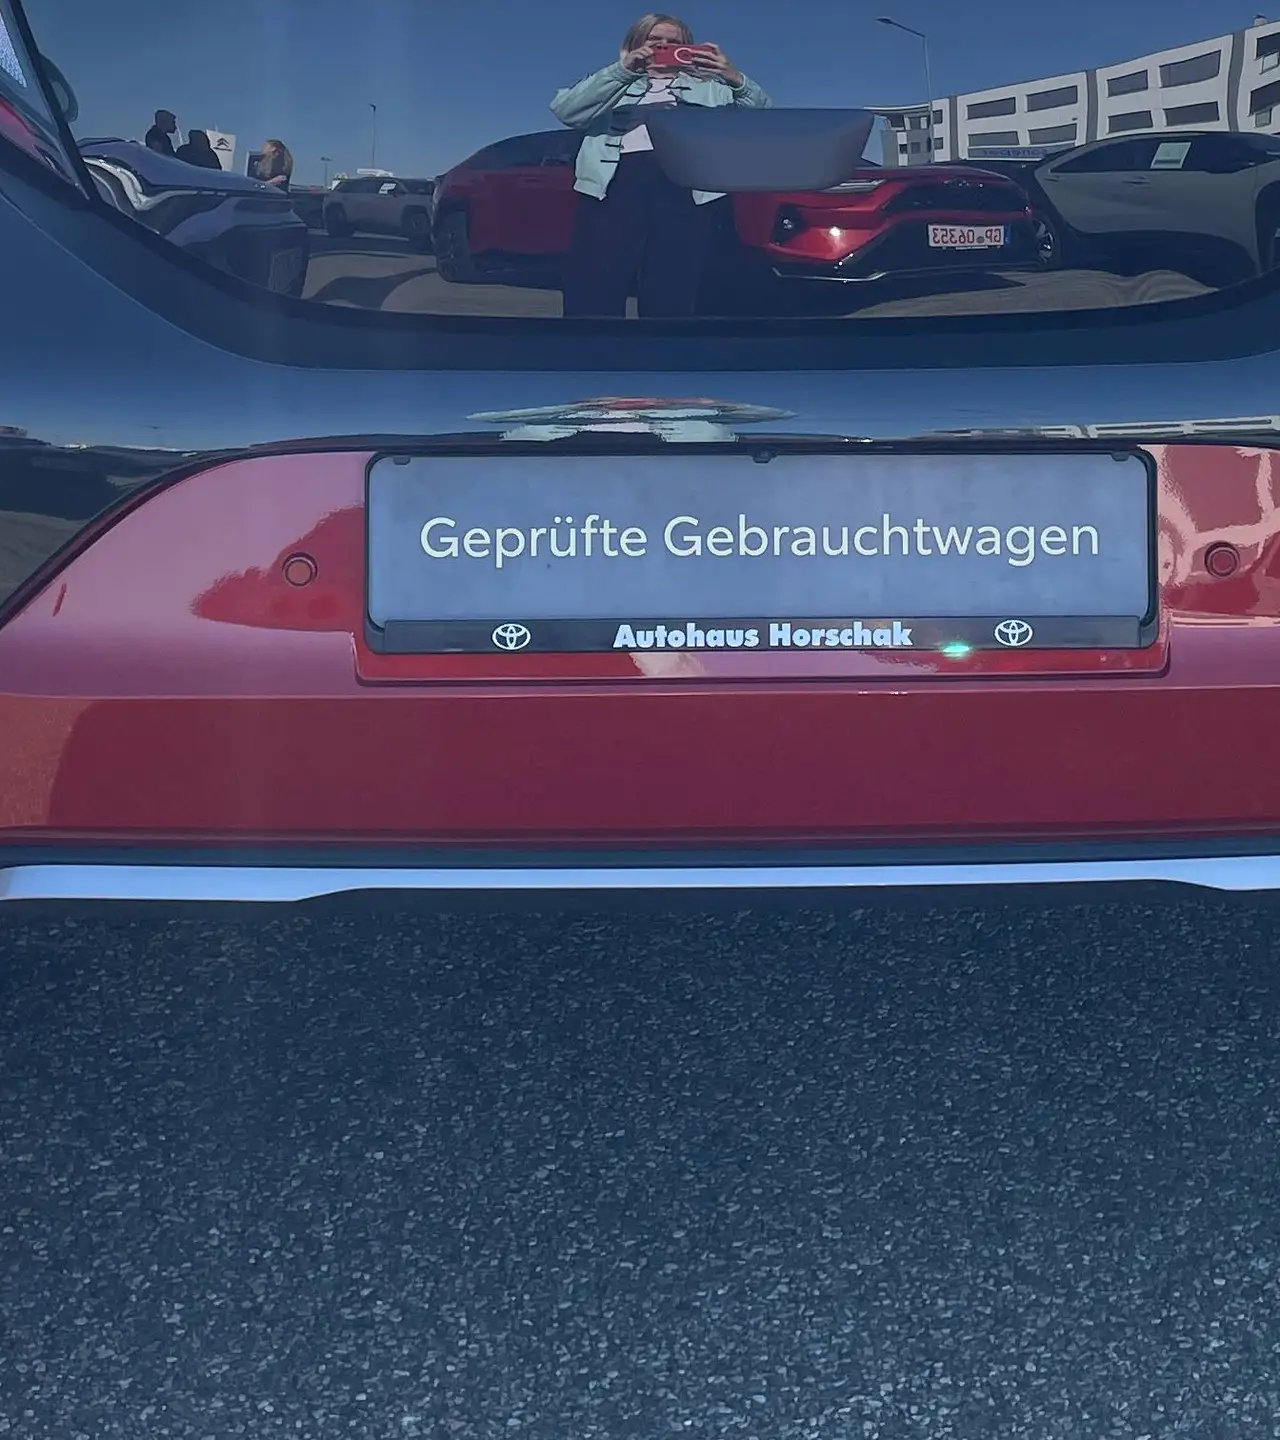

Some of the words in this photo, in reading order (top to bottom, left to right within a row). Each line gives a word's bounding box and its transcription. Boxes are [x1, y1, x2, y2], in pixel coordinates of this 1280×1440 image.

[420, 514, 648, 568] Geprüfte
[663, 513, 1099, 567] Gebrauchtwagen
[613, 622, 760, 648] Autohaus
[769, 621, 914, 648] Horschak
